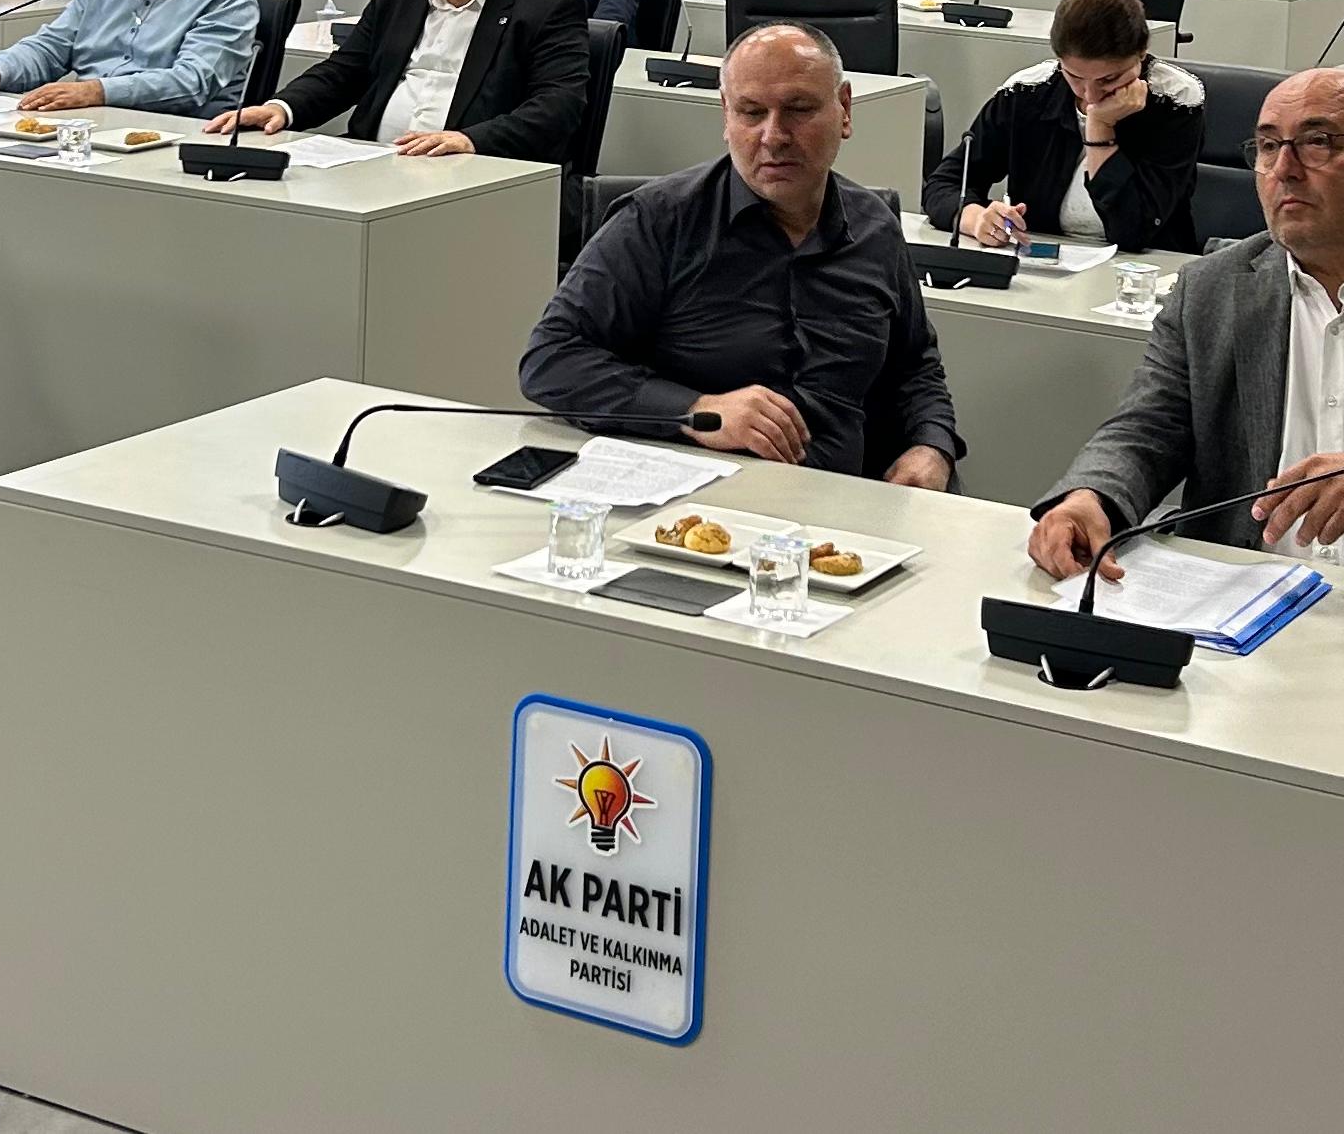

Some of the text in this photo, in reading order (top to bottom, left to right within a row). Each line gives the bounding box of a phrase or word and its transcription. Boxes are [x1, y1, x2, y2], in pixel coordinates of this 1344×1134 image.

[523, 859, 682, 936] AK PARTİ
[519, 916, 683, 976] ADALET VE KALKINMA
[570, 958, 632, 993] PARTİSİ
